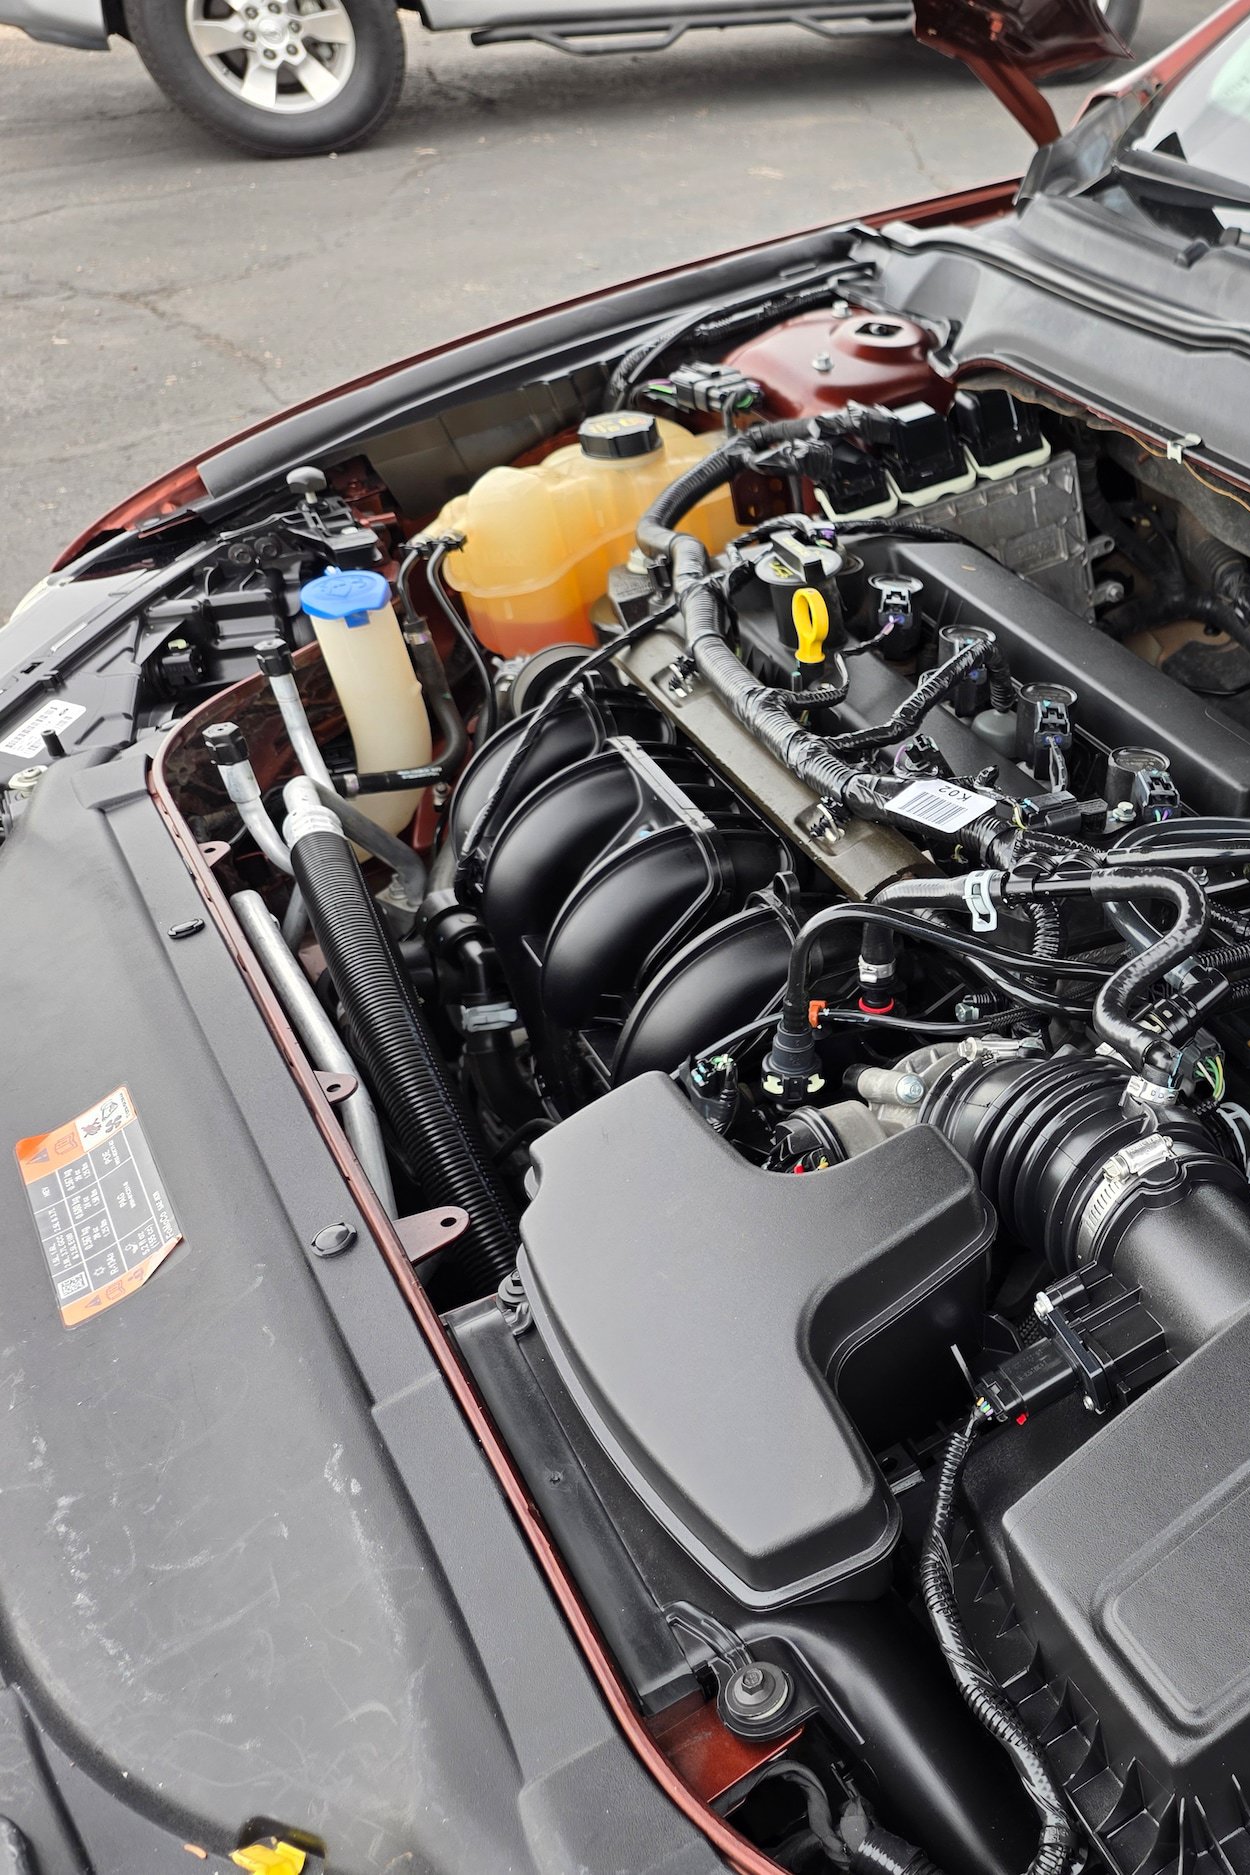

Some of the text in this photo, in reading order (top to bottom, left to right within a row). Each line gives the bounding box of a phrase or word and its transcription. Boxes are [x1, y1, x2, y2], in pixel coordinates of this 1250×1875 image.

[936, 784, 973, 802] K02
[102, 1149, 113, 1164] POE
[116, 1191, 128, 1208] PAG
[158, 1210, 175, 1239] FoMoCo
